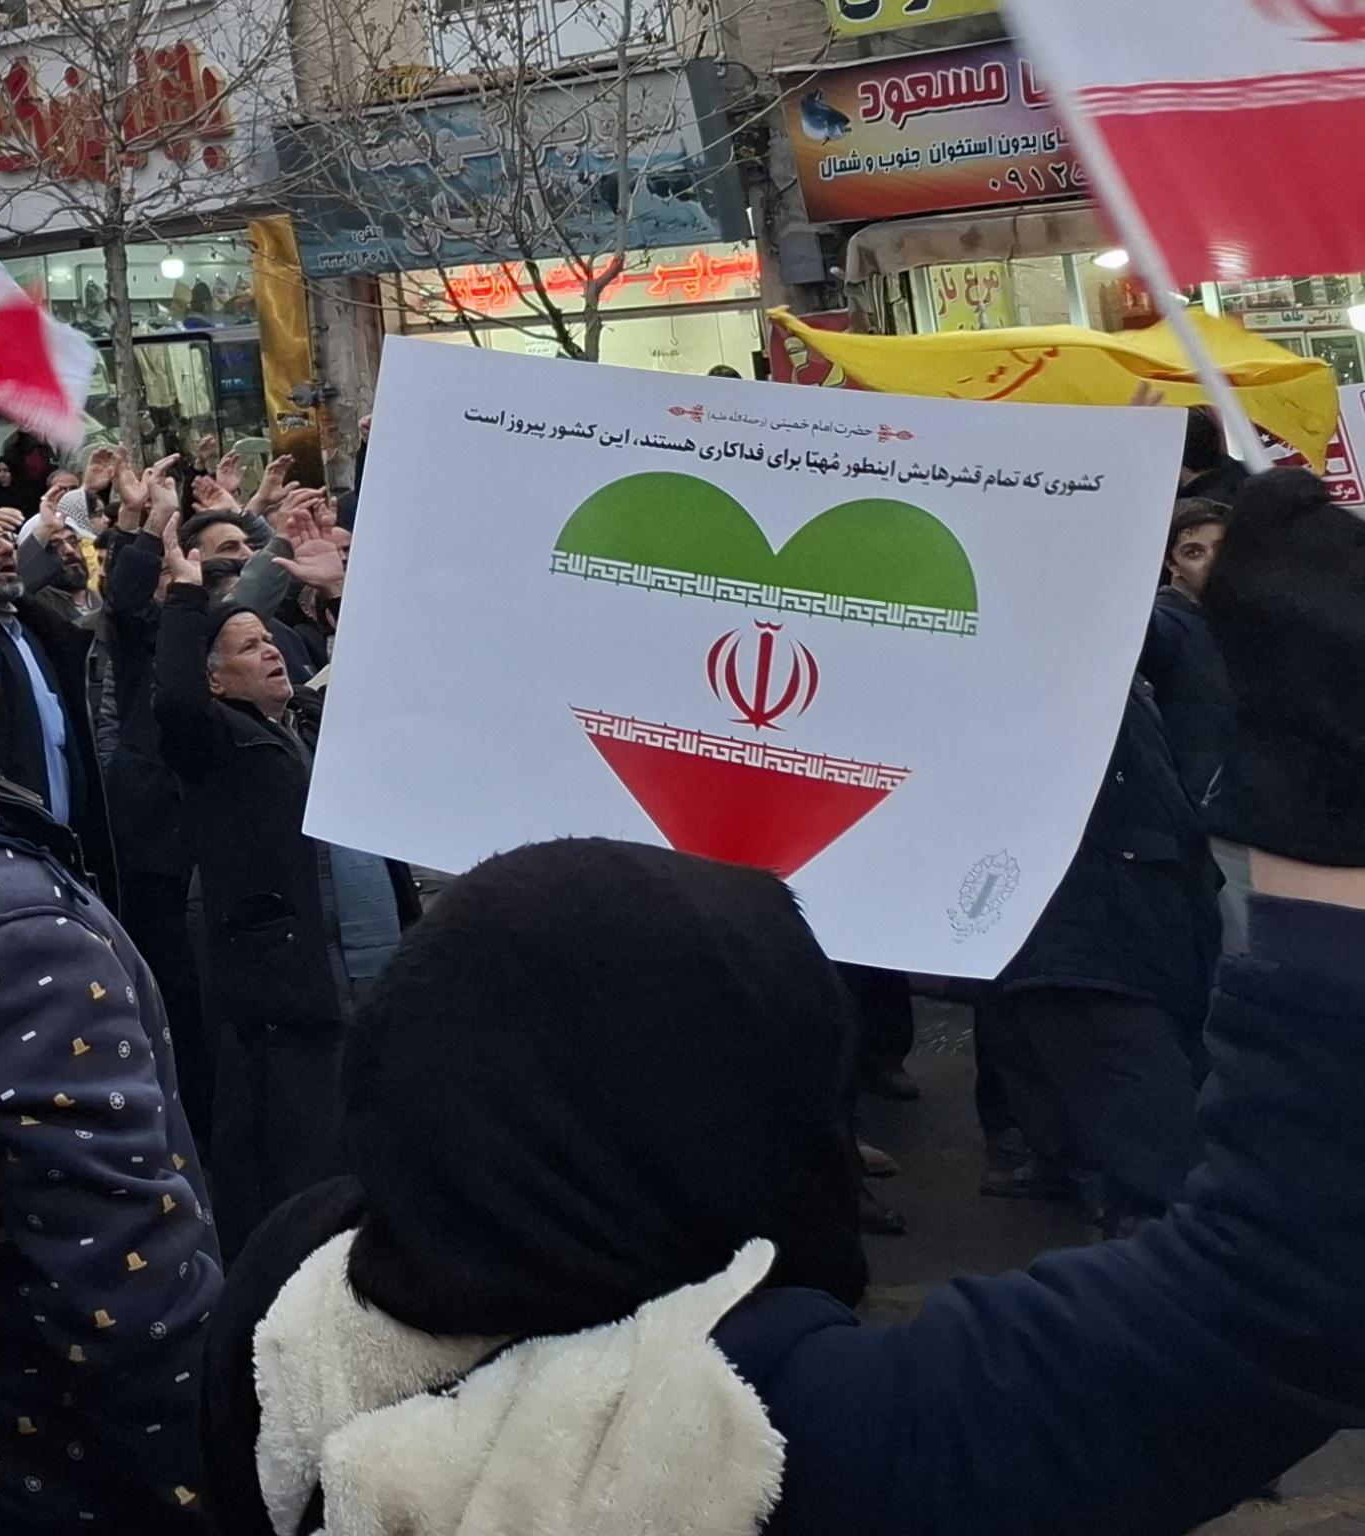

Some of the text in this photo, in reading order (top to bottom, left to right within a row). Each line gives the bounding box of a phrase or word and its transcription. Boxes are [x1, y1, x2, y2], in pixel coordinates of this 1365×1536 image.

[858, 62, 1009, 129] مسعود
[929, 137, 994, 164] استخوان
[999, 133, 1037, 156] بدون
[820, 151, 862, 180] شمال
[865, 154, 874, 173] و
[878, 148, 921, 170] جنوب
[648, 251, 758, 296] سوپر
[934, 266, 1000, 316] مرغ تاز
[463, 408, 507, 427] است
[508, 414, 547, 439] پیروز
[769, 419, 810, 433] خمینی
[811, 419, 833, 437] امام
[549, 422, 599, 440] کشور
[598, 428, 631, 449] این
[834, 423, 873, 439] حضرت
[698, 442, 765, 463] فداکاری
[767, 448, 803, 471] برای
[842, 457, 897, 482] اینطور
[898, 460, 983, 487] قشرهایش
[982, 467, 1021, 492] تمام
[1022, 471, 1045, 489] که
[1043, 474, 1105, 497] کشوری
[1329, 483, 1357, 501] مرگ
